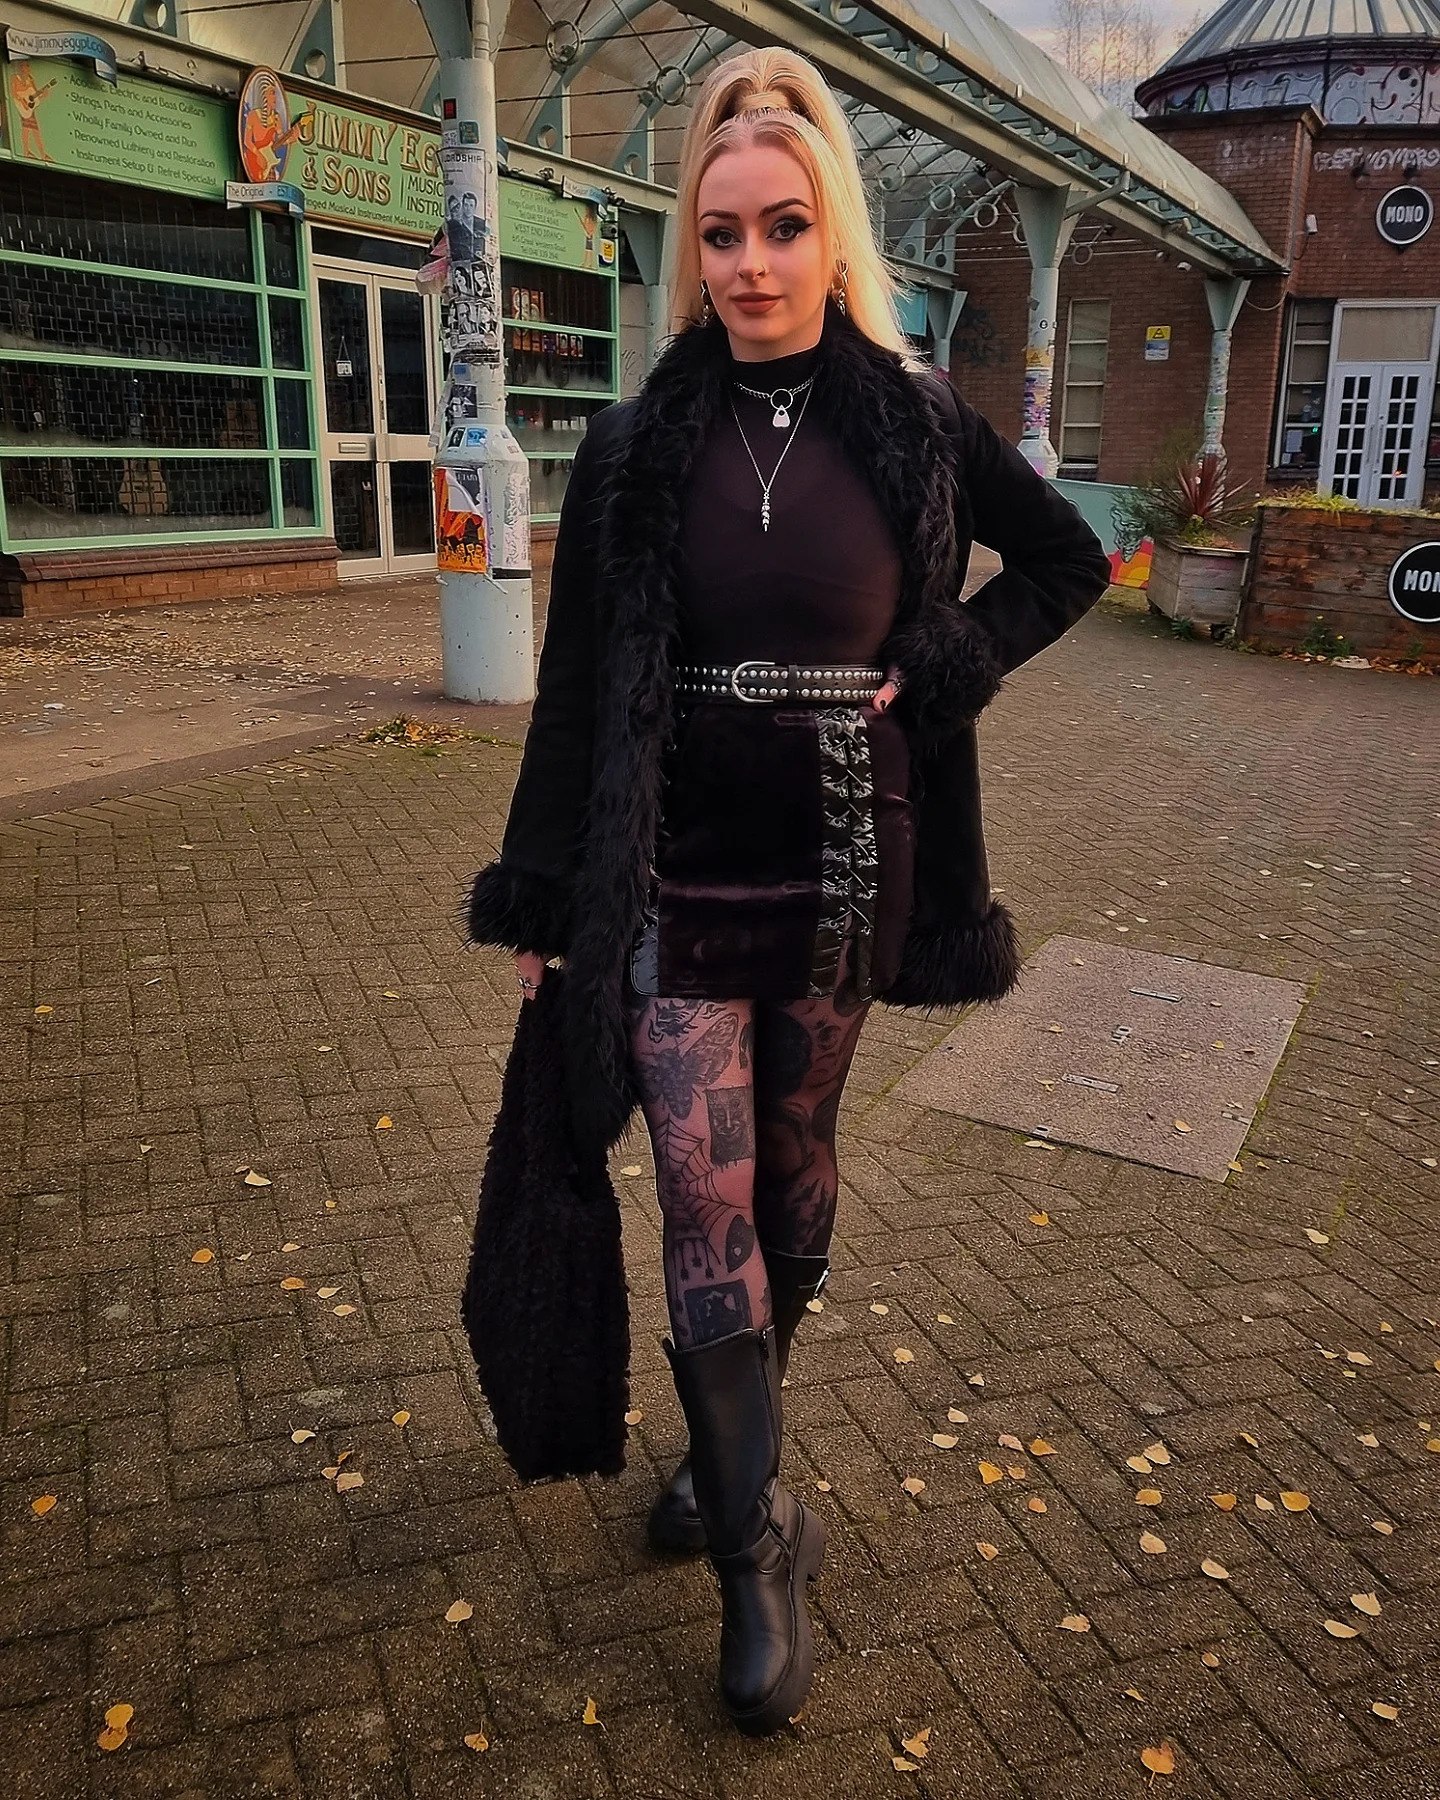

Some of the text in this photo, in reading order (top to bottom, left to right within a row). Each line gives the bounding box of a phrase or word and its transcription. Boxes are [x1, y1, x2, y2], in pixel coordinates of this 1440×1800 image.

[104, 100, 126, 115] Parts
[128, 108, 143, 118] and
[145, 111, 192, 130] Accessories
[159, 97, 178, 110] Bass
[73, 111, 197, 148] Wholly Family Owned and Run
[298, 101, 439, 178] JIMMY EG
[75, 129, 120, 148] Renowned
[156, 150, 172, 160] and
[173, 151, 216, 168] Restoration
[76, 149, 121, 166] Instrument
[122, 158, 146, 172] Setup
[228, 184, 240, 197] The
[301, 150, 392, 206] & SONS
[329, 201, 356, 215] Musical
[357, 207, 395, 223] Instrument
[395, 215, 417, 228] Makers
[407, 196, 445, 219] INSTRU
[1385, 205, 1424, 225] MONO
[1403, 569, 1440, 593] MON
